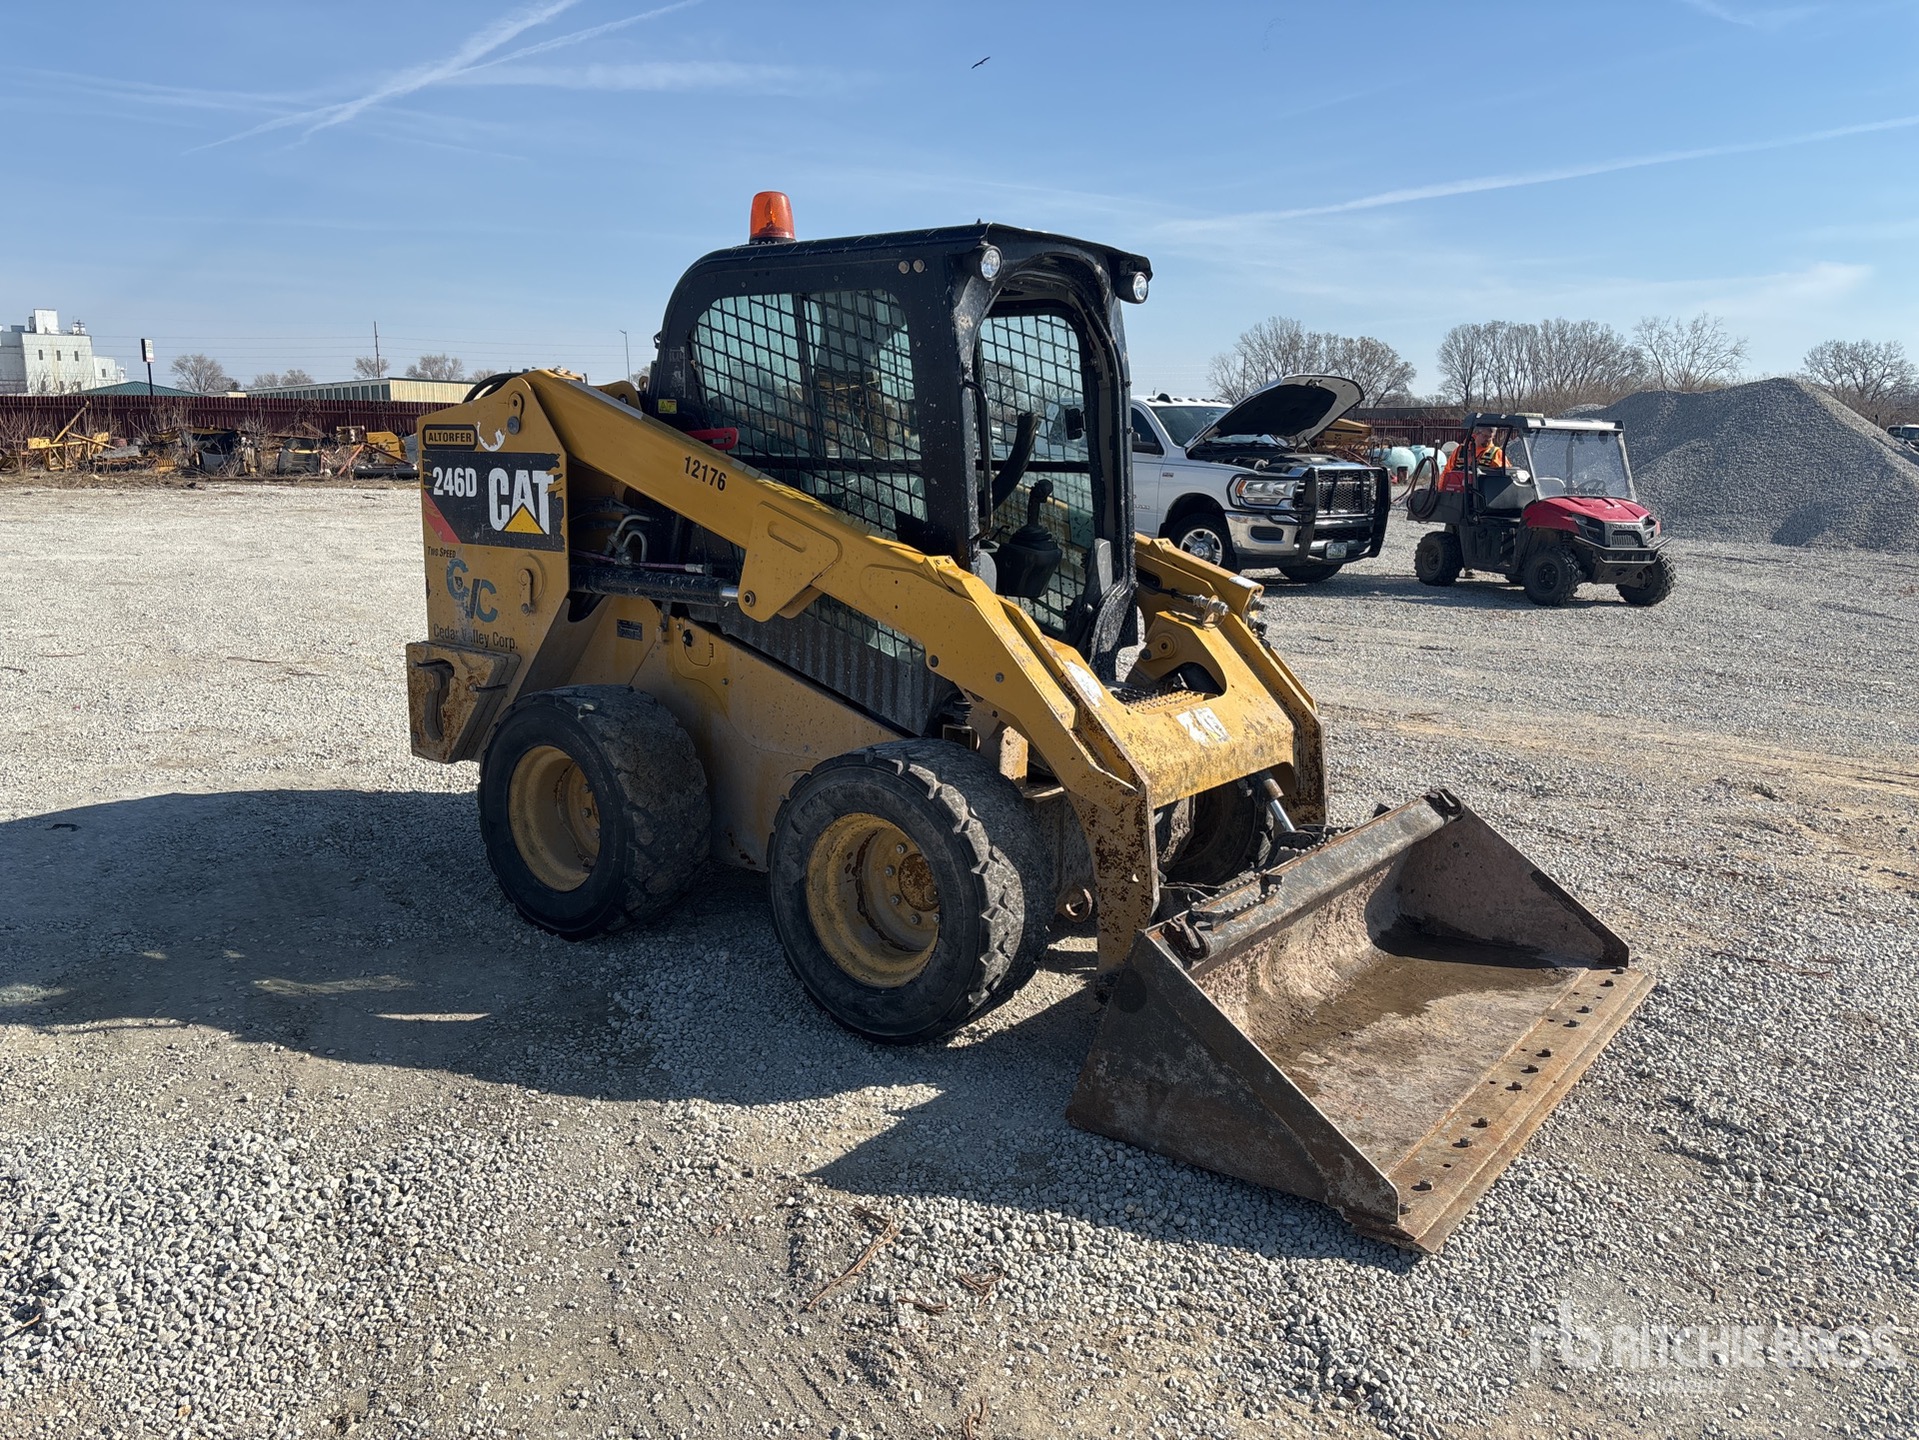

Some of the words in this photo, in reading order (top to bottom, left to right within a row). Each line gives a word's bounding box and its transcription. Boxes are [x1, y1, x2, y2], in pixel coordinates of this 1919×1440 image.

[428, 432, 472, 443] ALTORFER
[432, 467, 477, 497] 246D
[685, 456, 727, 491] 12176
[488, 467, 554, 535] CAT
[461, 627, 489, 648] Vlley
[492, 631, 518, 652] Corp.
